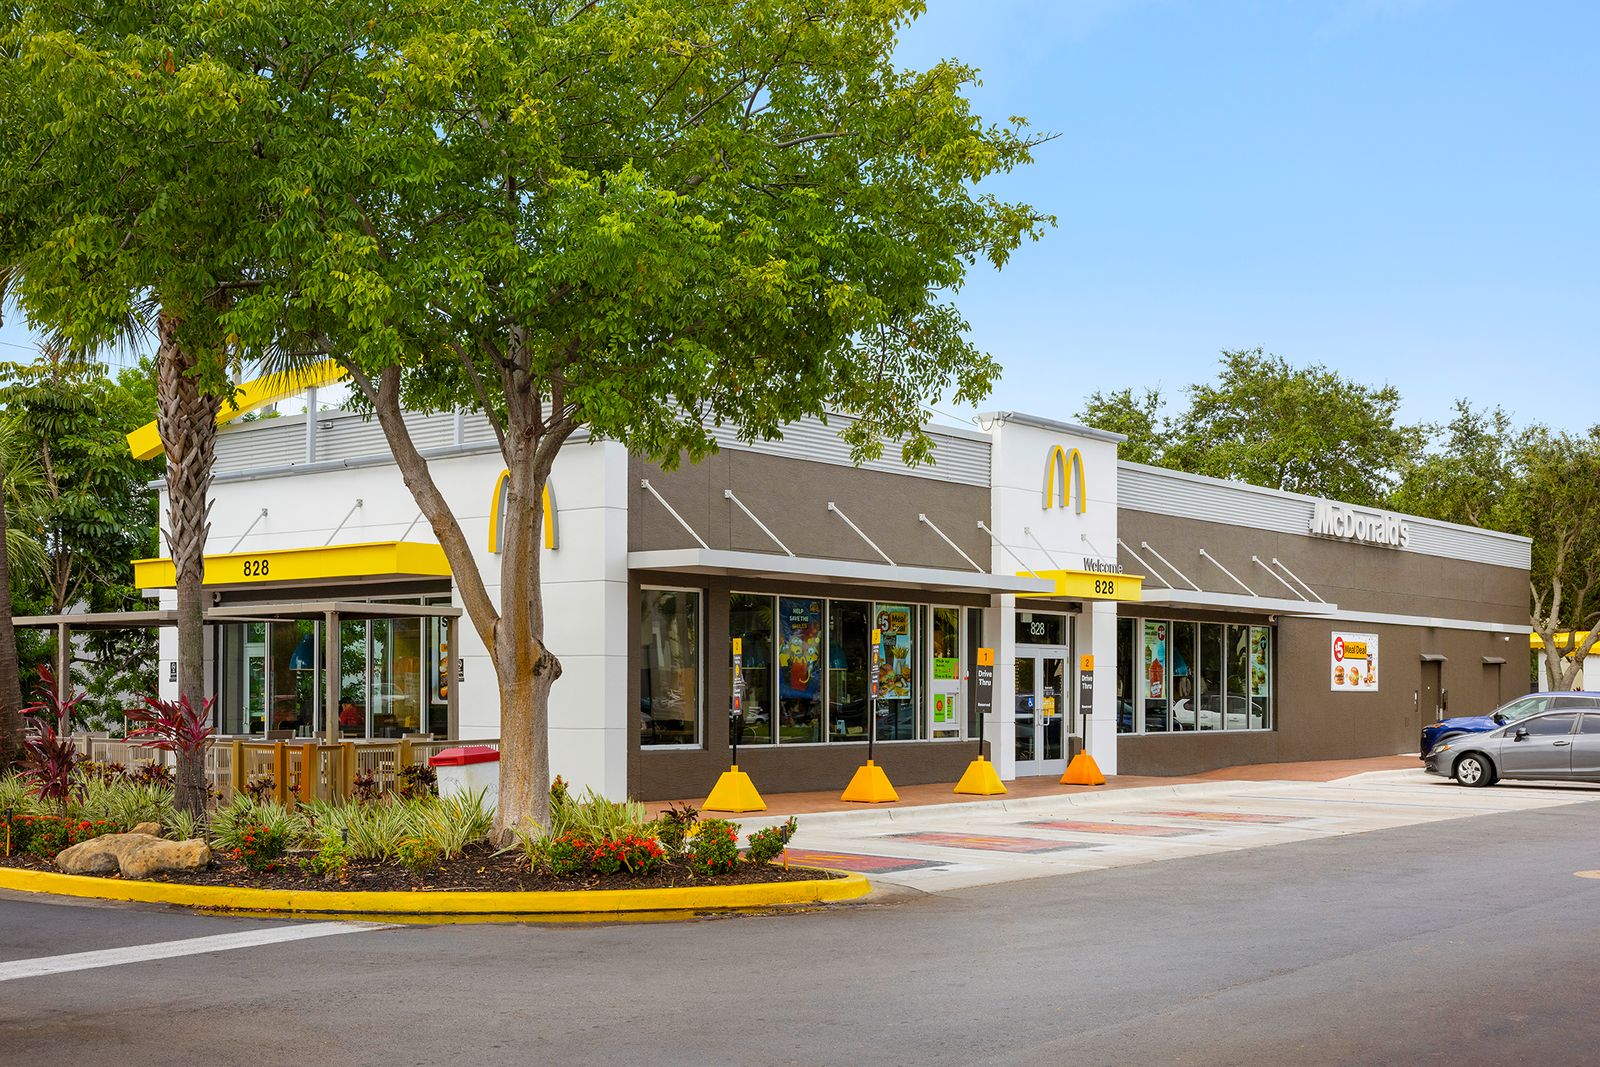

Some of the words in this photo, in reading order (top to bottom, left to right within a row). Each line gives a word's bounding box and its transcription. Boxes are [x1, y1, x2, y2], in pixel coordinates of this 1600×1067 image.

[1309, 502, 1410, 548] McDonald's
[244, 560, 269, 576] 828
[1083, 557, 1123, 574] Welcome
[1095, 580, 1114, 594] 828
[1030, 622, 1045, 635] 828
[1345, 645, 1356, 655] Meal
[1356, 645, 1367, 655] Deal
[984, 652, 988, 662] 1
[1084, 658, 1090, 667] 2
[978, 670, 992, 678] Drive
[978, 678, 992, 686] Thru
